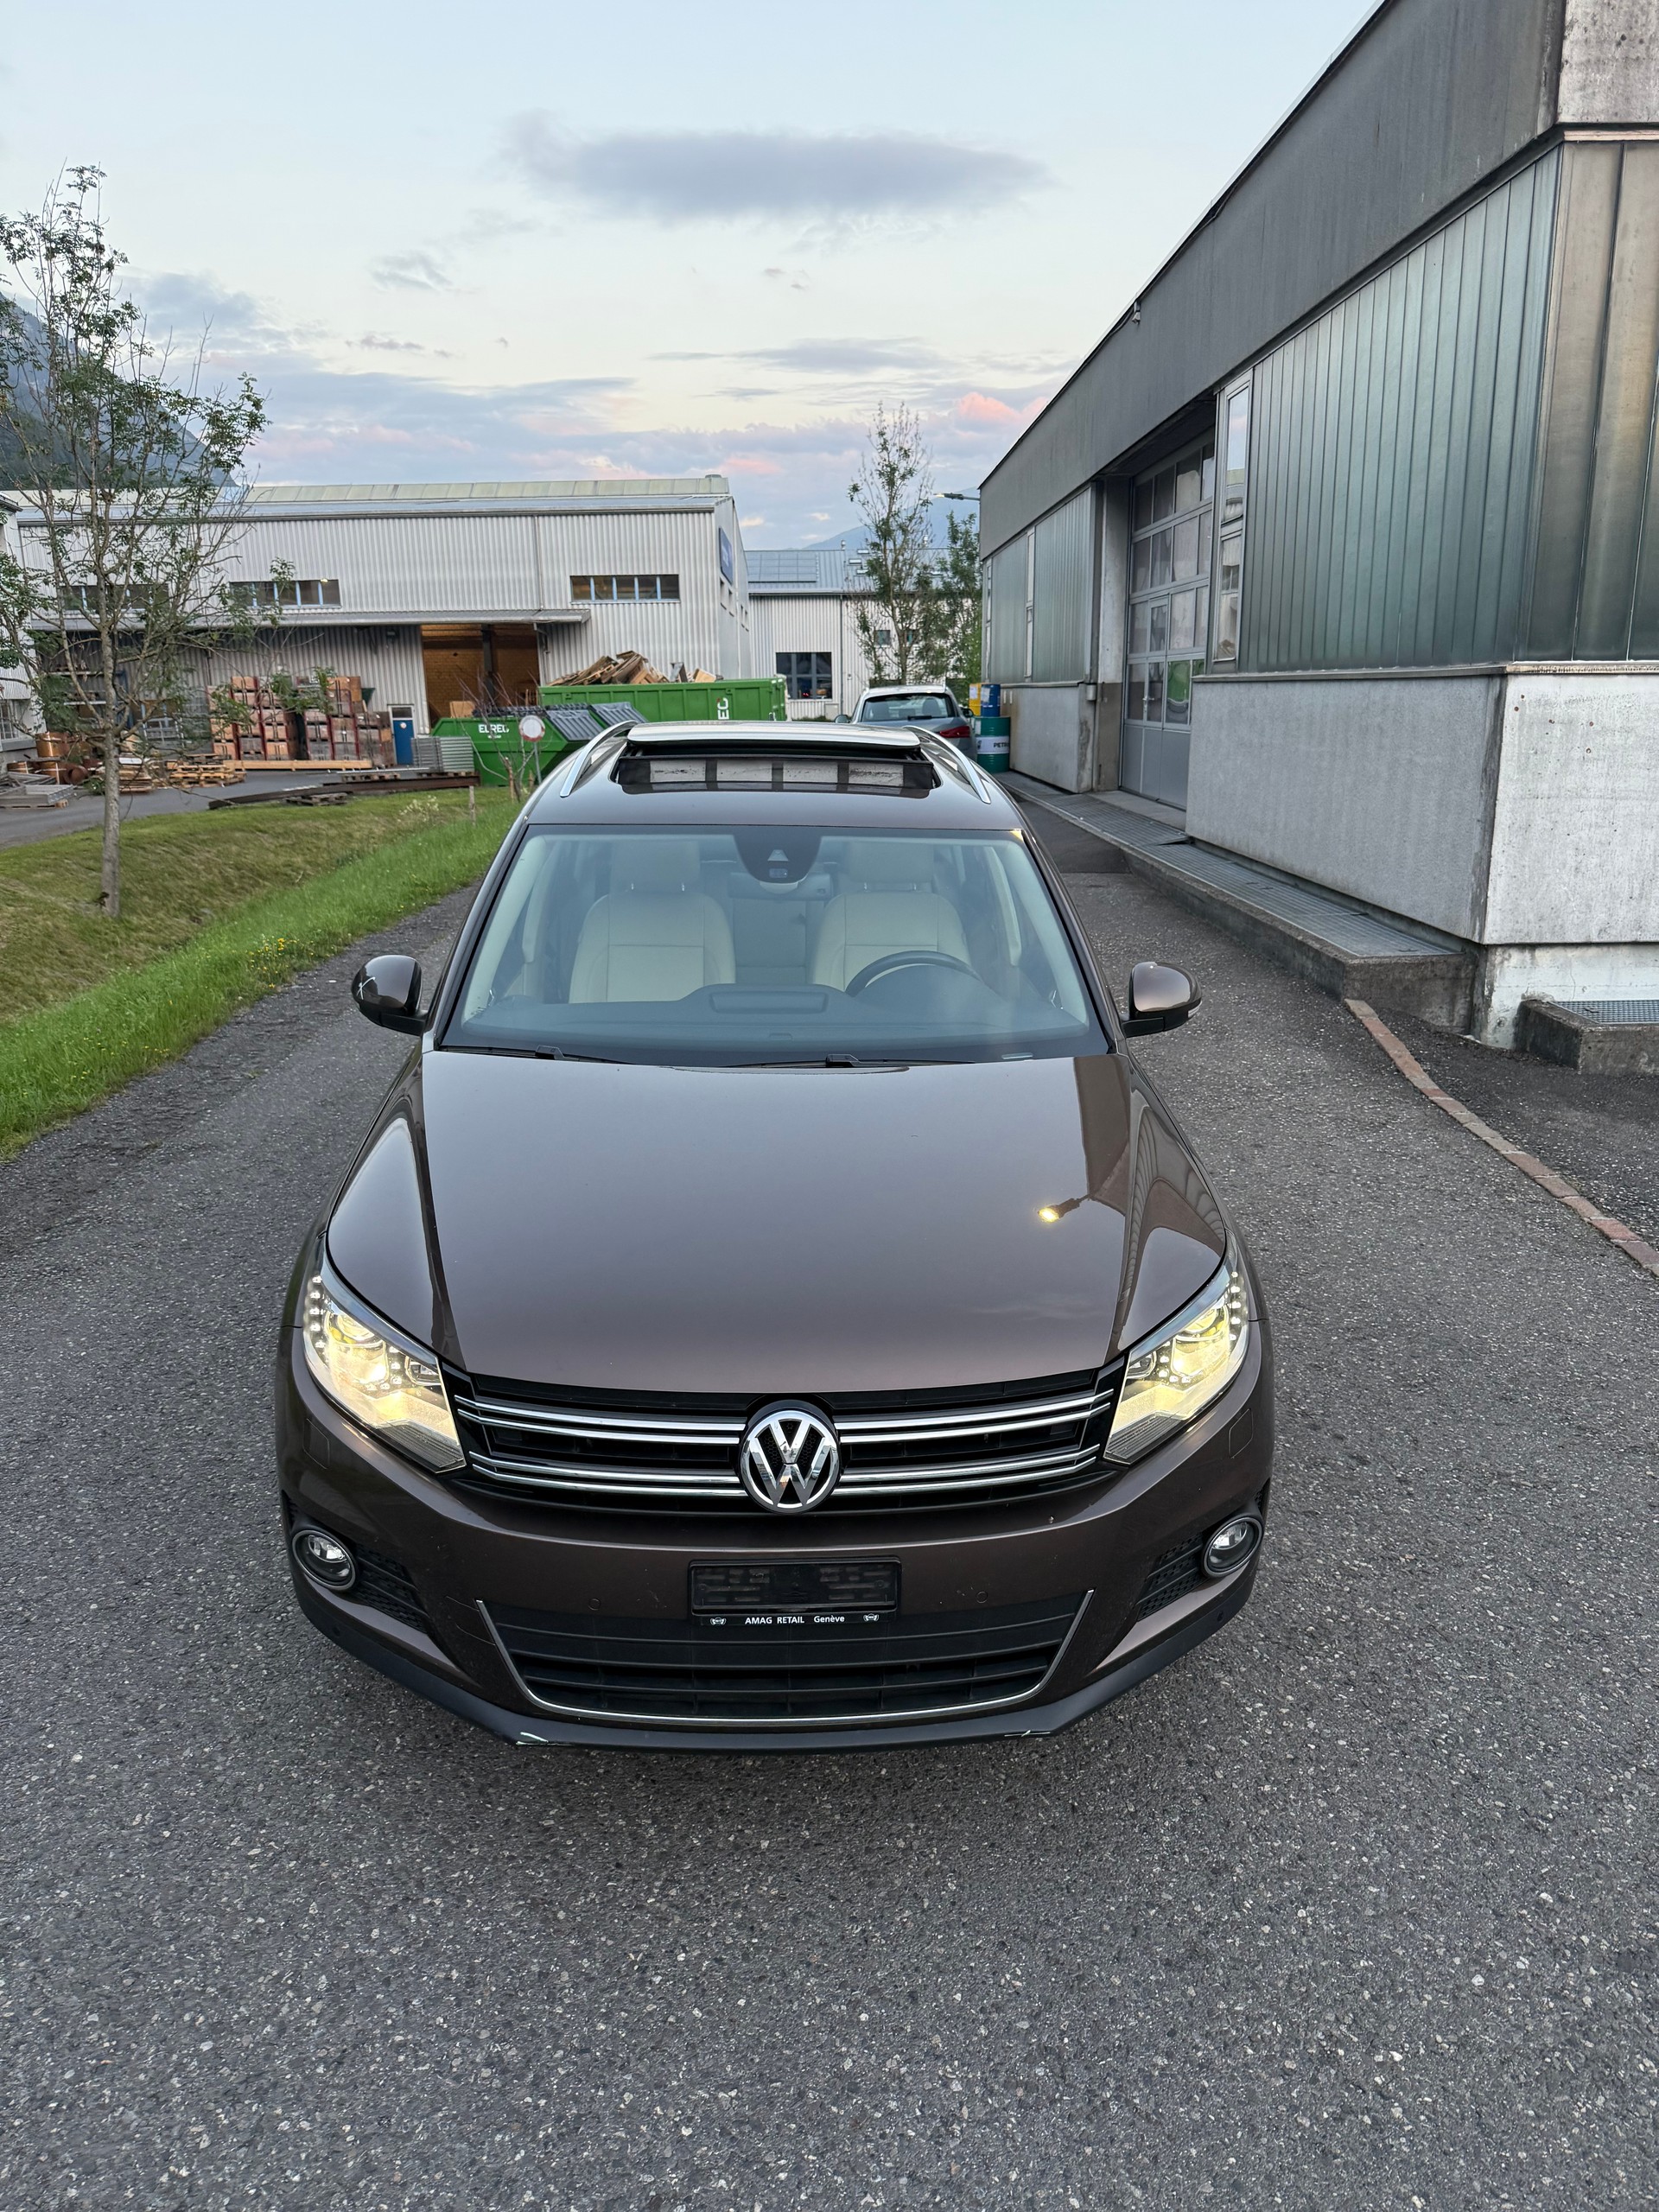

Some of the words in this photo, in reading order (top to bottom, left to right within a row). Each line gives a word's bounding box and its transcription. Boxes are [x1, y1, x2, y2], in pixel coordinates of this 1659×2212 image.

[741, 1410, 840, 1514] VW
[777, 1616, 805, 1624] RETAIL
[813, 1614, 845, 1624] Genève
